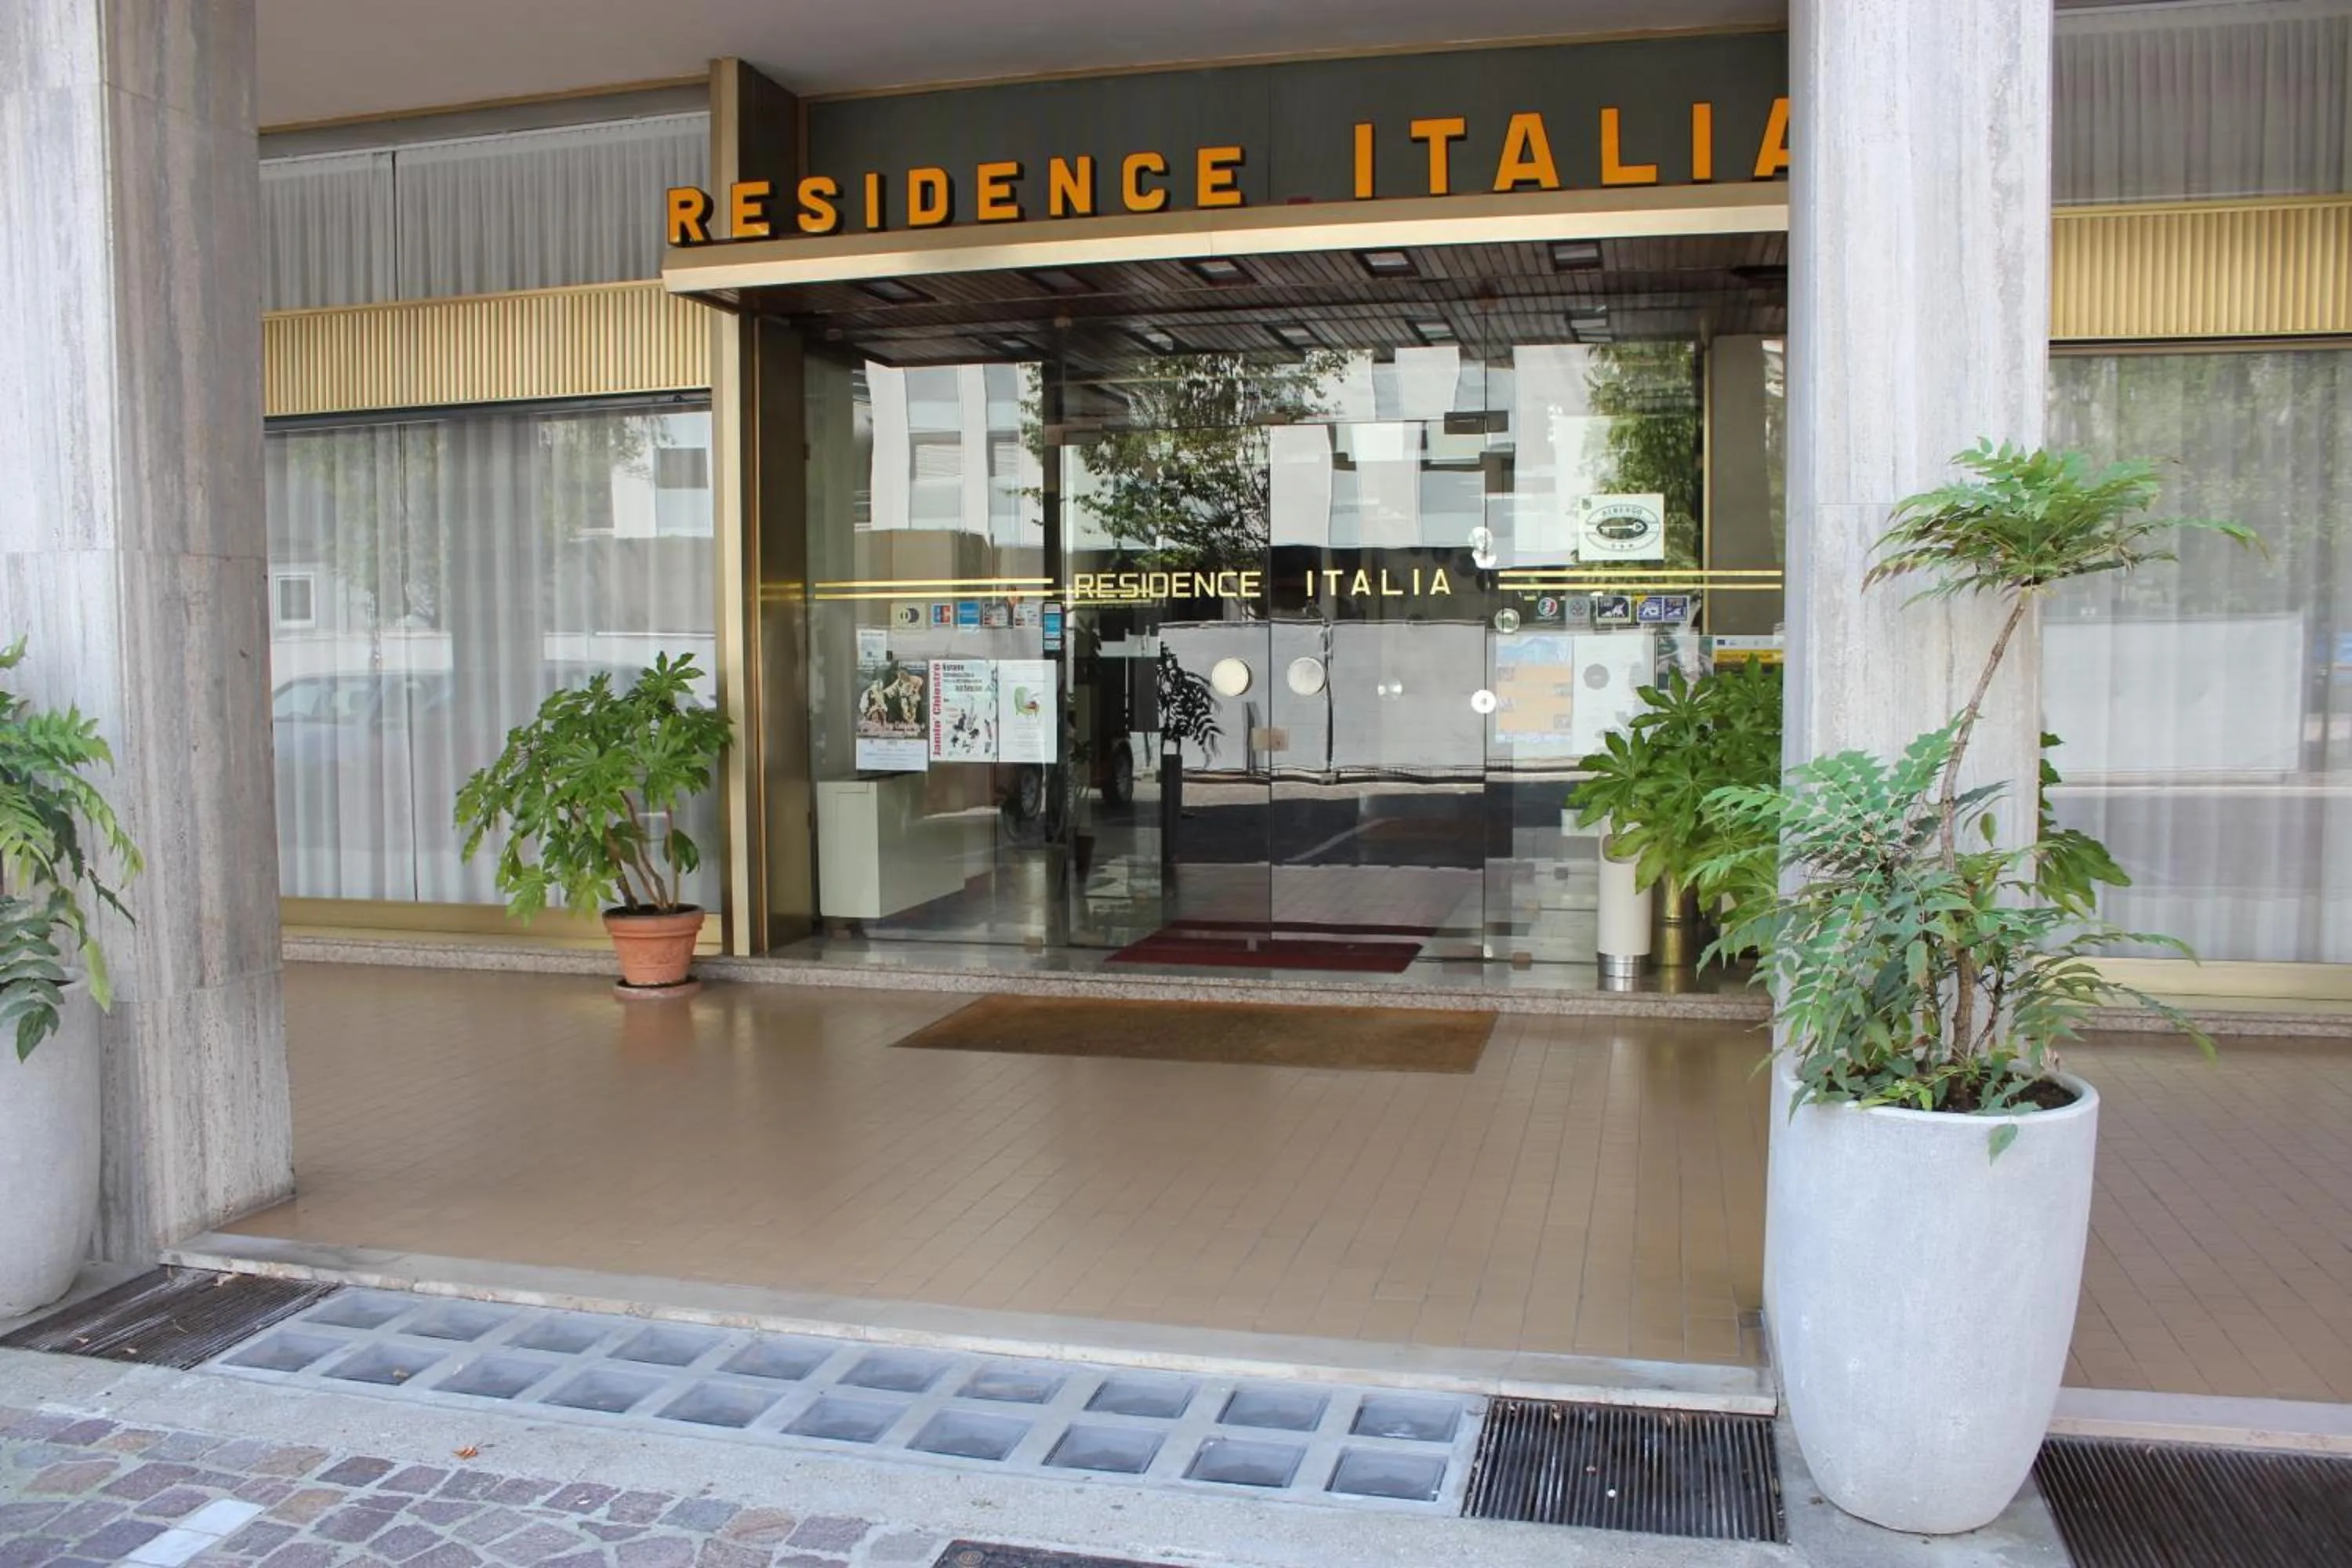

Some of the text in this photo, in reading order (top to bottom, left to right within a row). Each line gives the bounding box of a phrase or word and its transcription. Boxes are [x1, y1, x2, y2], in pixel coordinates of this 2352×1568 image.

[667, 146, 1245, 245] RESIDENCE
[1073, 568, 1452, 598] RESIDENCE ITALIA
